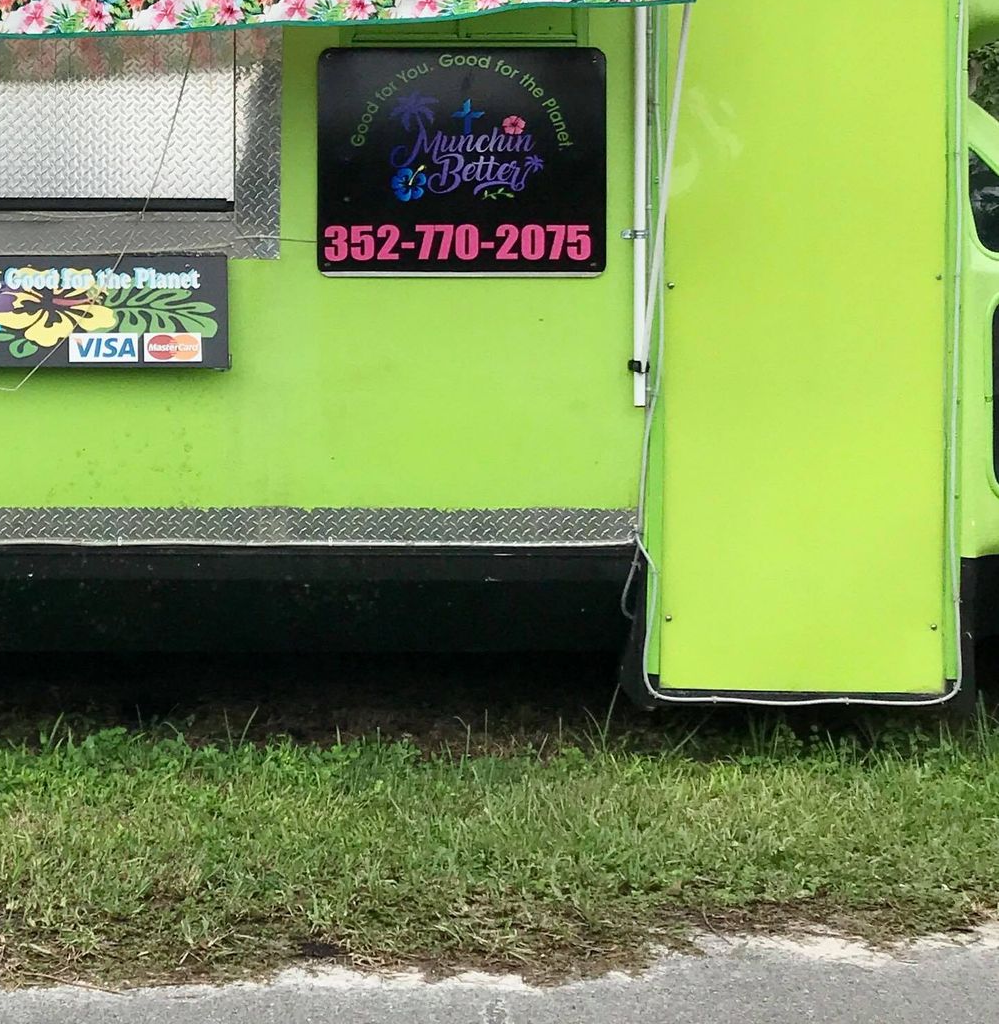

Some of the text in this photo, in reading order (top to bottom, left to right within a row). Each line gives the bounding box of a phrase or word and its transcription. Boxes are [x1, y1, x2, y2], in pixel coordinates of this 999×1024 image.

[351, 53, 574, 151] Good for You. Good for the Planet.
[390, 126, 535, 168] Munchin
[427, 153, 534, 195] Better
[324, 224, 593, 262] 352-770-2075
[4, 266, 59, 290] Good
[61, 267, 95, 290] for
[95, 267, 132, 290] the
[132, 267, 201, 291] Planet
[74, 337, 200, 358] VISA MasterCard
